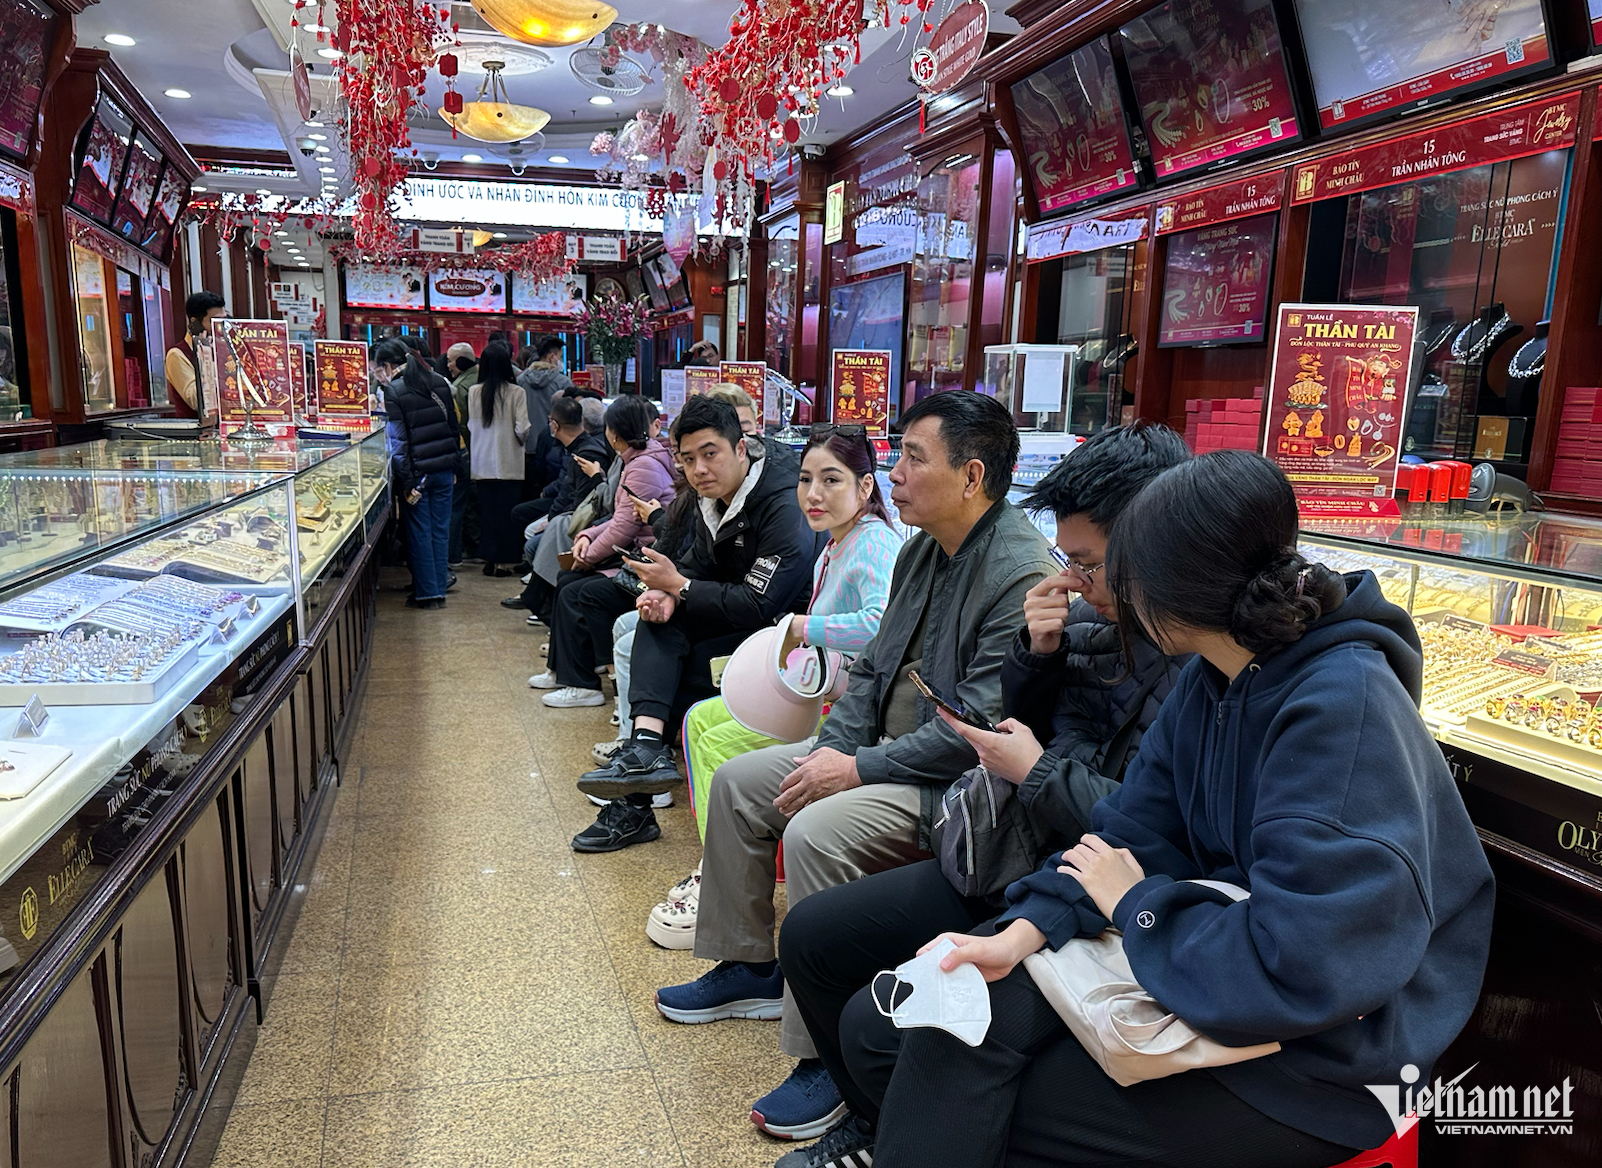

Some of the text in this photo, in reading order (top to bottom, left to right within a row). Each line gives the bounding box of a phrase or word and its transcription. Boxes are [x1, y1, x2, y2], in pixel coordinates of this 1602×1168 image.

[968, 12, 984, 43] STYLE
[1251, 95, 1270, 112] 30%
[1423, 138, 1436, 156] 15
[1347, 159, 1361, 175] TÍN
[1391, 149, 1468, 178] TRẦN NHÂN TÔNG
[1344, 172, 1365, 188] CHÂU
[468, 183, 483, 200] VÀ
[558, 187, 584, 206] HÔN
[588, 192, 609, 207] KIM
[1247, 184, 1256, 198] 15
[1225, 194, 1276, 215] TRẦN NHÂN TÔNG
[1460, 202, 1480, 213] TRANG
[1506, 193, 1532, 206] PHONG
[1531, 188, 1552, 202] CÁCH
[260, 328, 278, 342] TÀI
[1303, 318, 1397, 341] THẦN TÀI
[324, 344, 361, 356] THẦN TÀI
[1331, 340, 1342, 349] TÀI
[1379, 343, 1400, 351] KHANG
[843, 354, 884, 367] THẦN TÀI
[728, 365, 761, 377] THẦN TÀI
[107, 783, 130, 819] TRANG
[151, 741, 171, 773] PHONG
[1464, 763, 1474, 783] Ý
[1574, 846, 1590, 860] MEN
